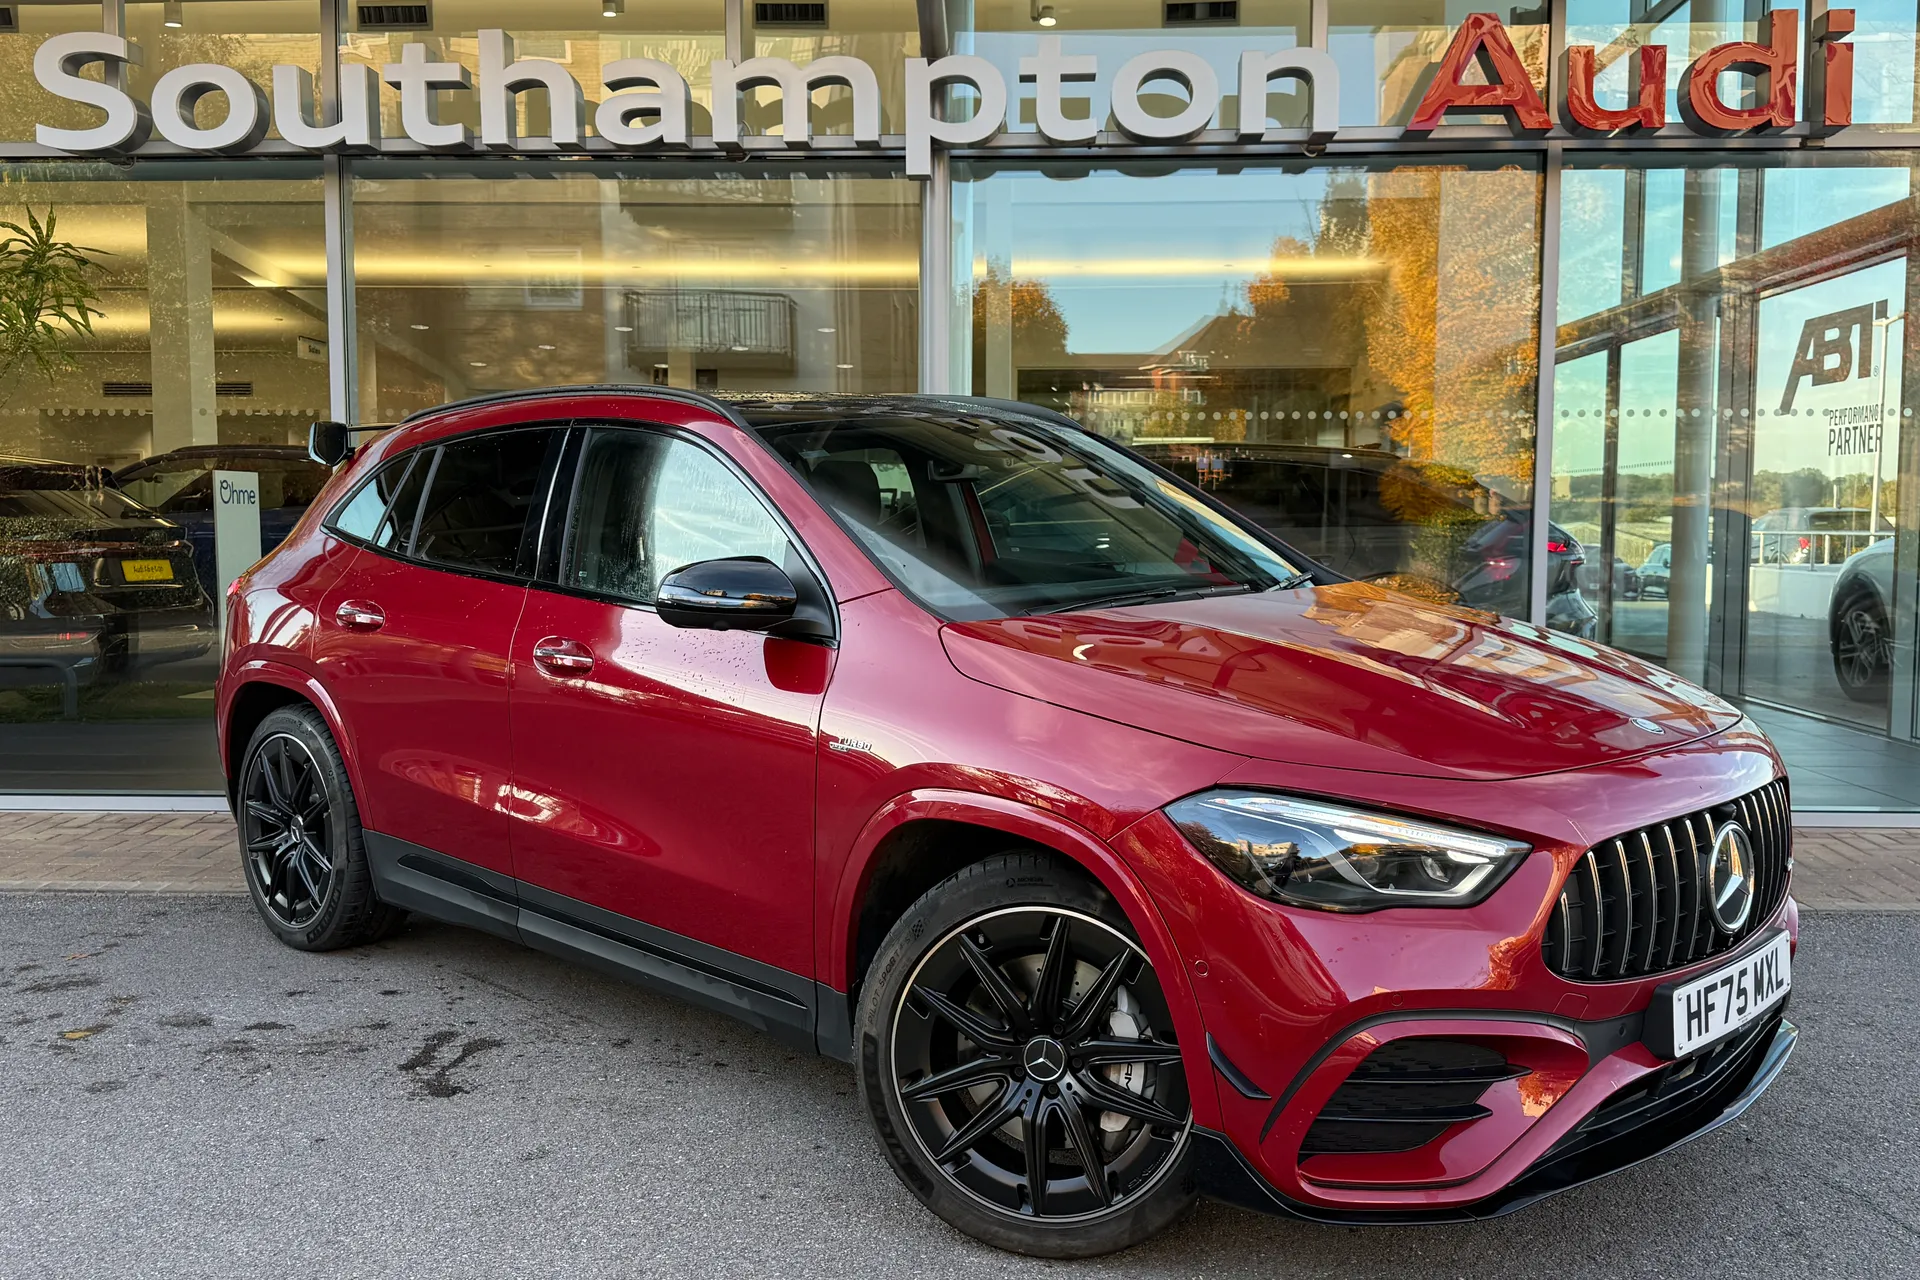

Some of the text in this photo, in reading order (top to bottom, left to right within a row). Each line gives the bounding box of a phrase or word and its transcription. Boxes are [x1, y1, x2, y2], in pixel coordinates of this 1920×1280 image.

[33, 9, 1855, 178] Southampton Audi
[1779, 298, 1889, 416] ABT
[1828, 423, 1884, 457] PARTNER
[219, 479, 256, 505] Ohme
[839, 737, 873, 751] TURBO
[867, 989, 881, 1025] PILOT
[879, 949, 900, 988] SPORT
[1686, 947, 1784, 1042] HF75 MXL
